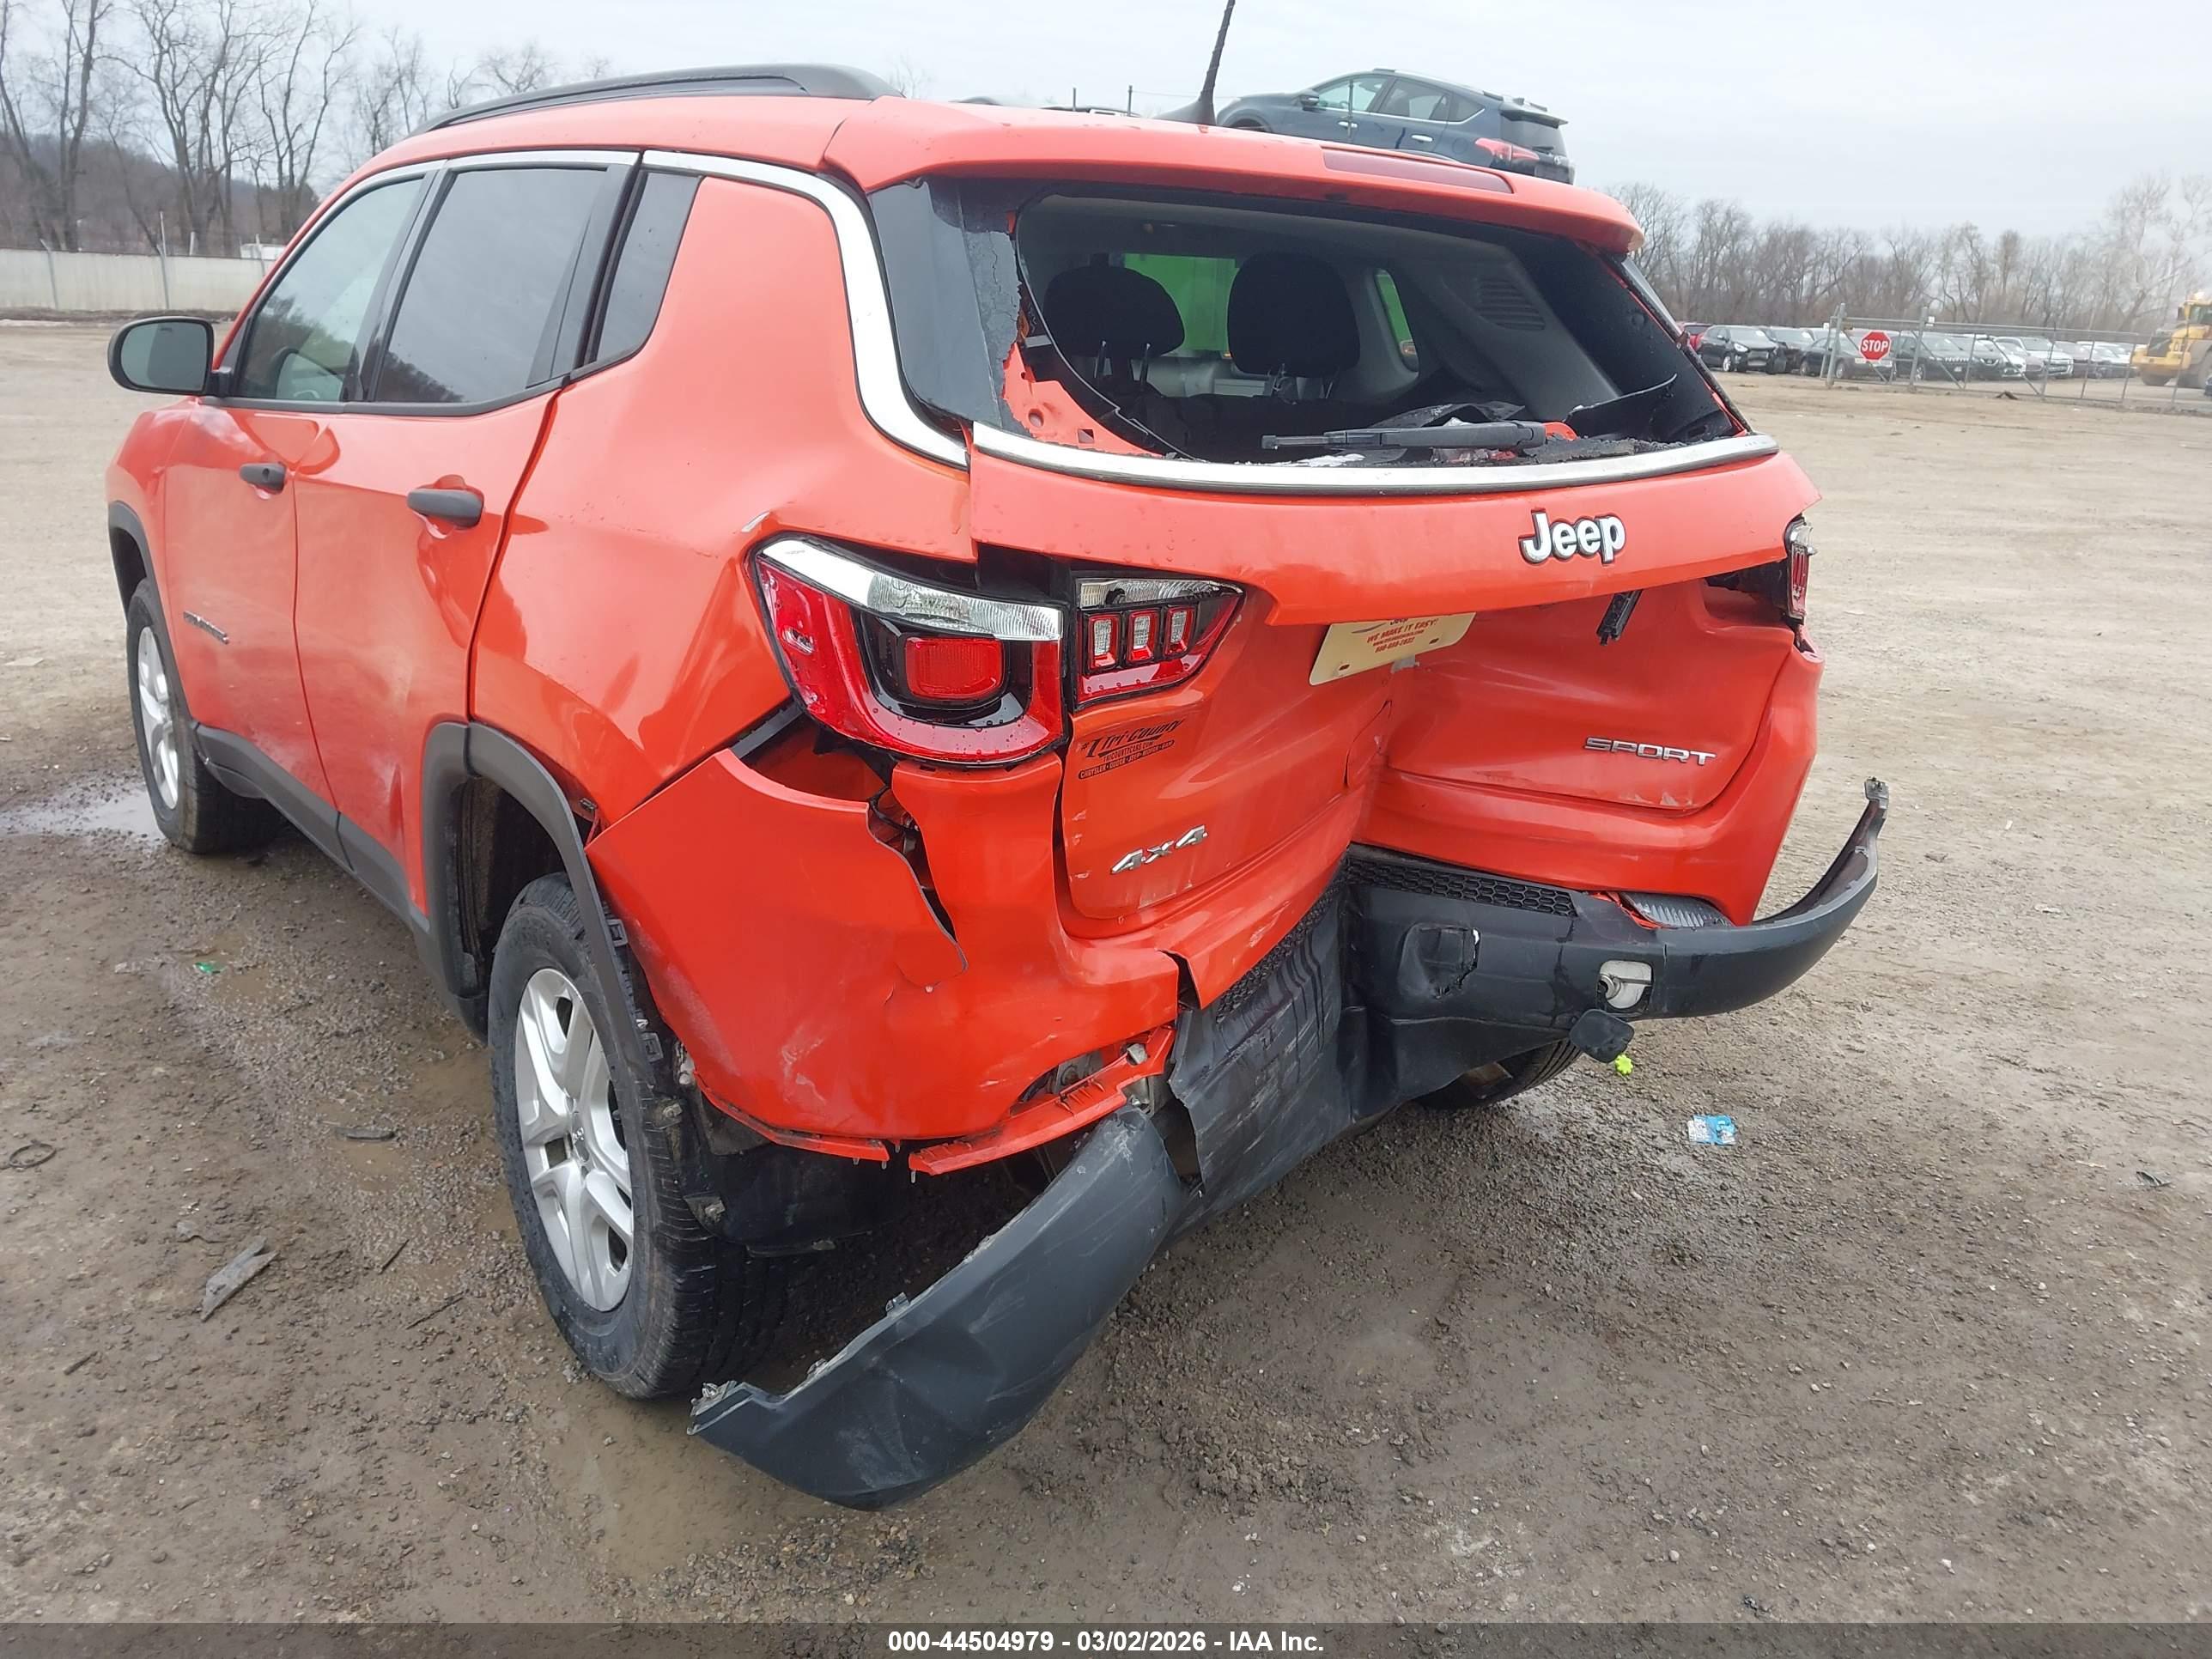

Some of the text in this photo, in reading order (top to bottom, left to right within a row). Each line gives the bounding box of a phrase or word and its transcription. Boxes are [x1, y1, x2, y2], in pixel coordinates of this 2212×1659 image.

[1862, 339, 1888, 352] STOP
[1520, 509, 1626, 564] Jeep
[1381, 626, 1402, 639] MAKE
[1404, 623, 1413, 632] IT
[1584, 736, 1717, 767] SPORT
